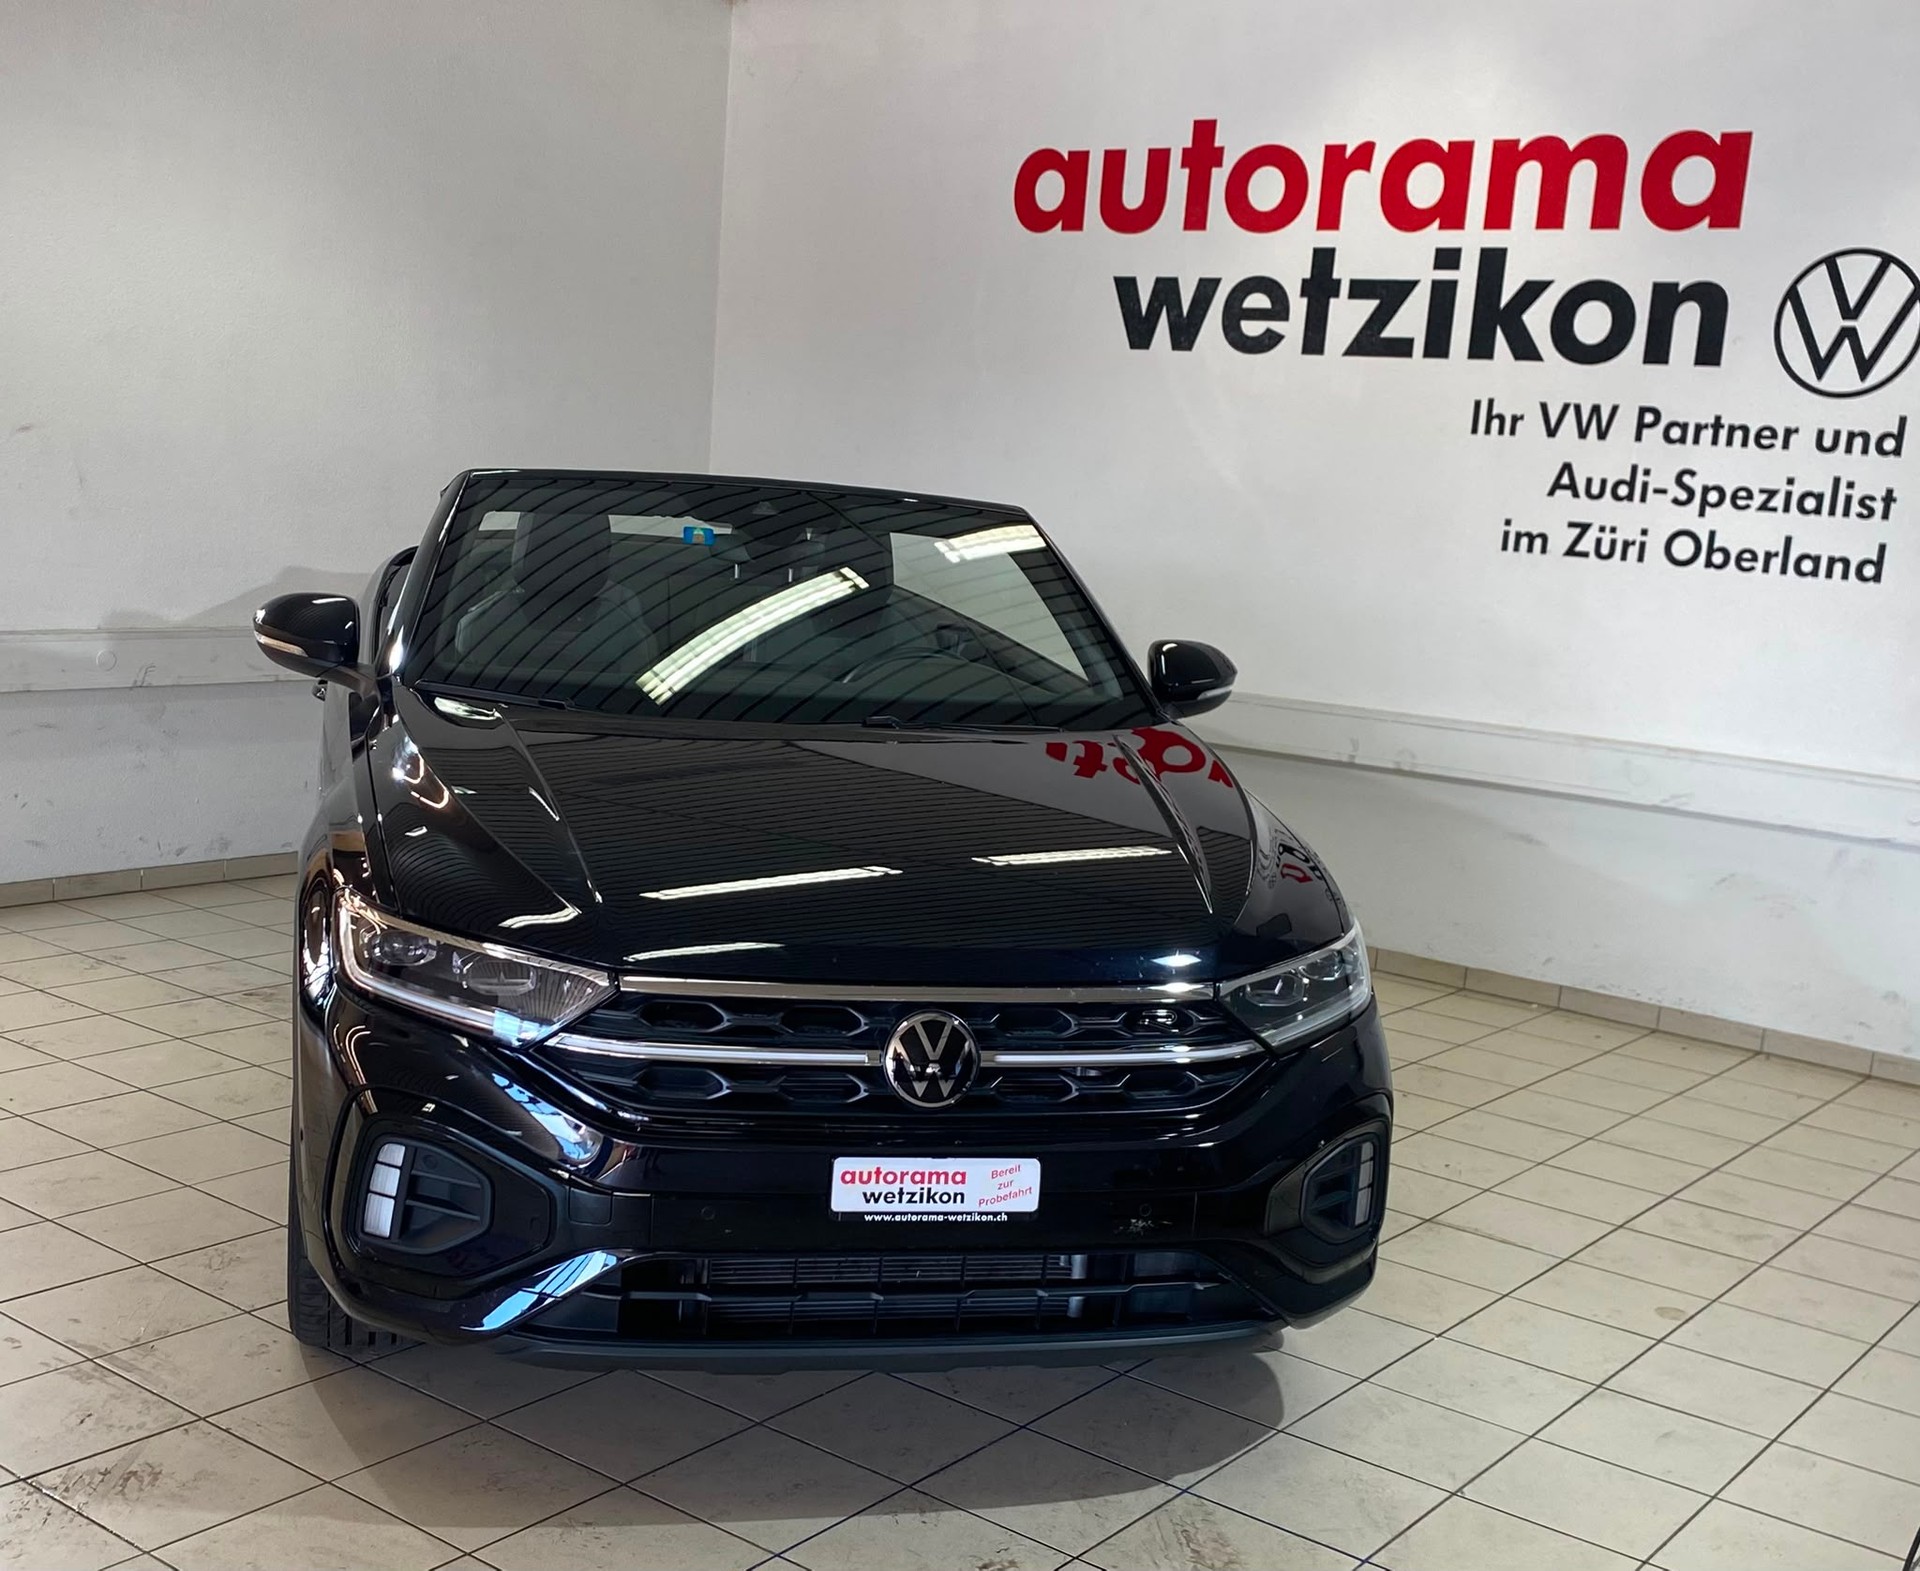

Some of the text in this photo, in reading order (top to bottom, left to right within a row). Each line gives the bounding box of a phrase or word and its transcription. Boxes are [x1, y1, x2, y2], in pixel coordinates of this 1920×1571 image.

[1013, 119, 1753, 235] autorama
[1113, 247, 1729, 367] wetzikon
[1470, 398, 1908, 457] Ihr VW Partner und
[1546, 462, 1897, 521] Audi-Spezialist
[1501, 518, 1887, 584] im Züri Oberland
[840, 1166, 967, 1185] autorama
[991, 1164, 1021, 1180] Bereit
[862, 1187, 965, 1204] wetzikon
[997, 1179, 1014, 1190] zur
[978, 1186, 1033, 1208] Probefahrt
[864, 1212, 1008, 1222] www.autorama-wetzikon.ch
